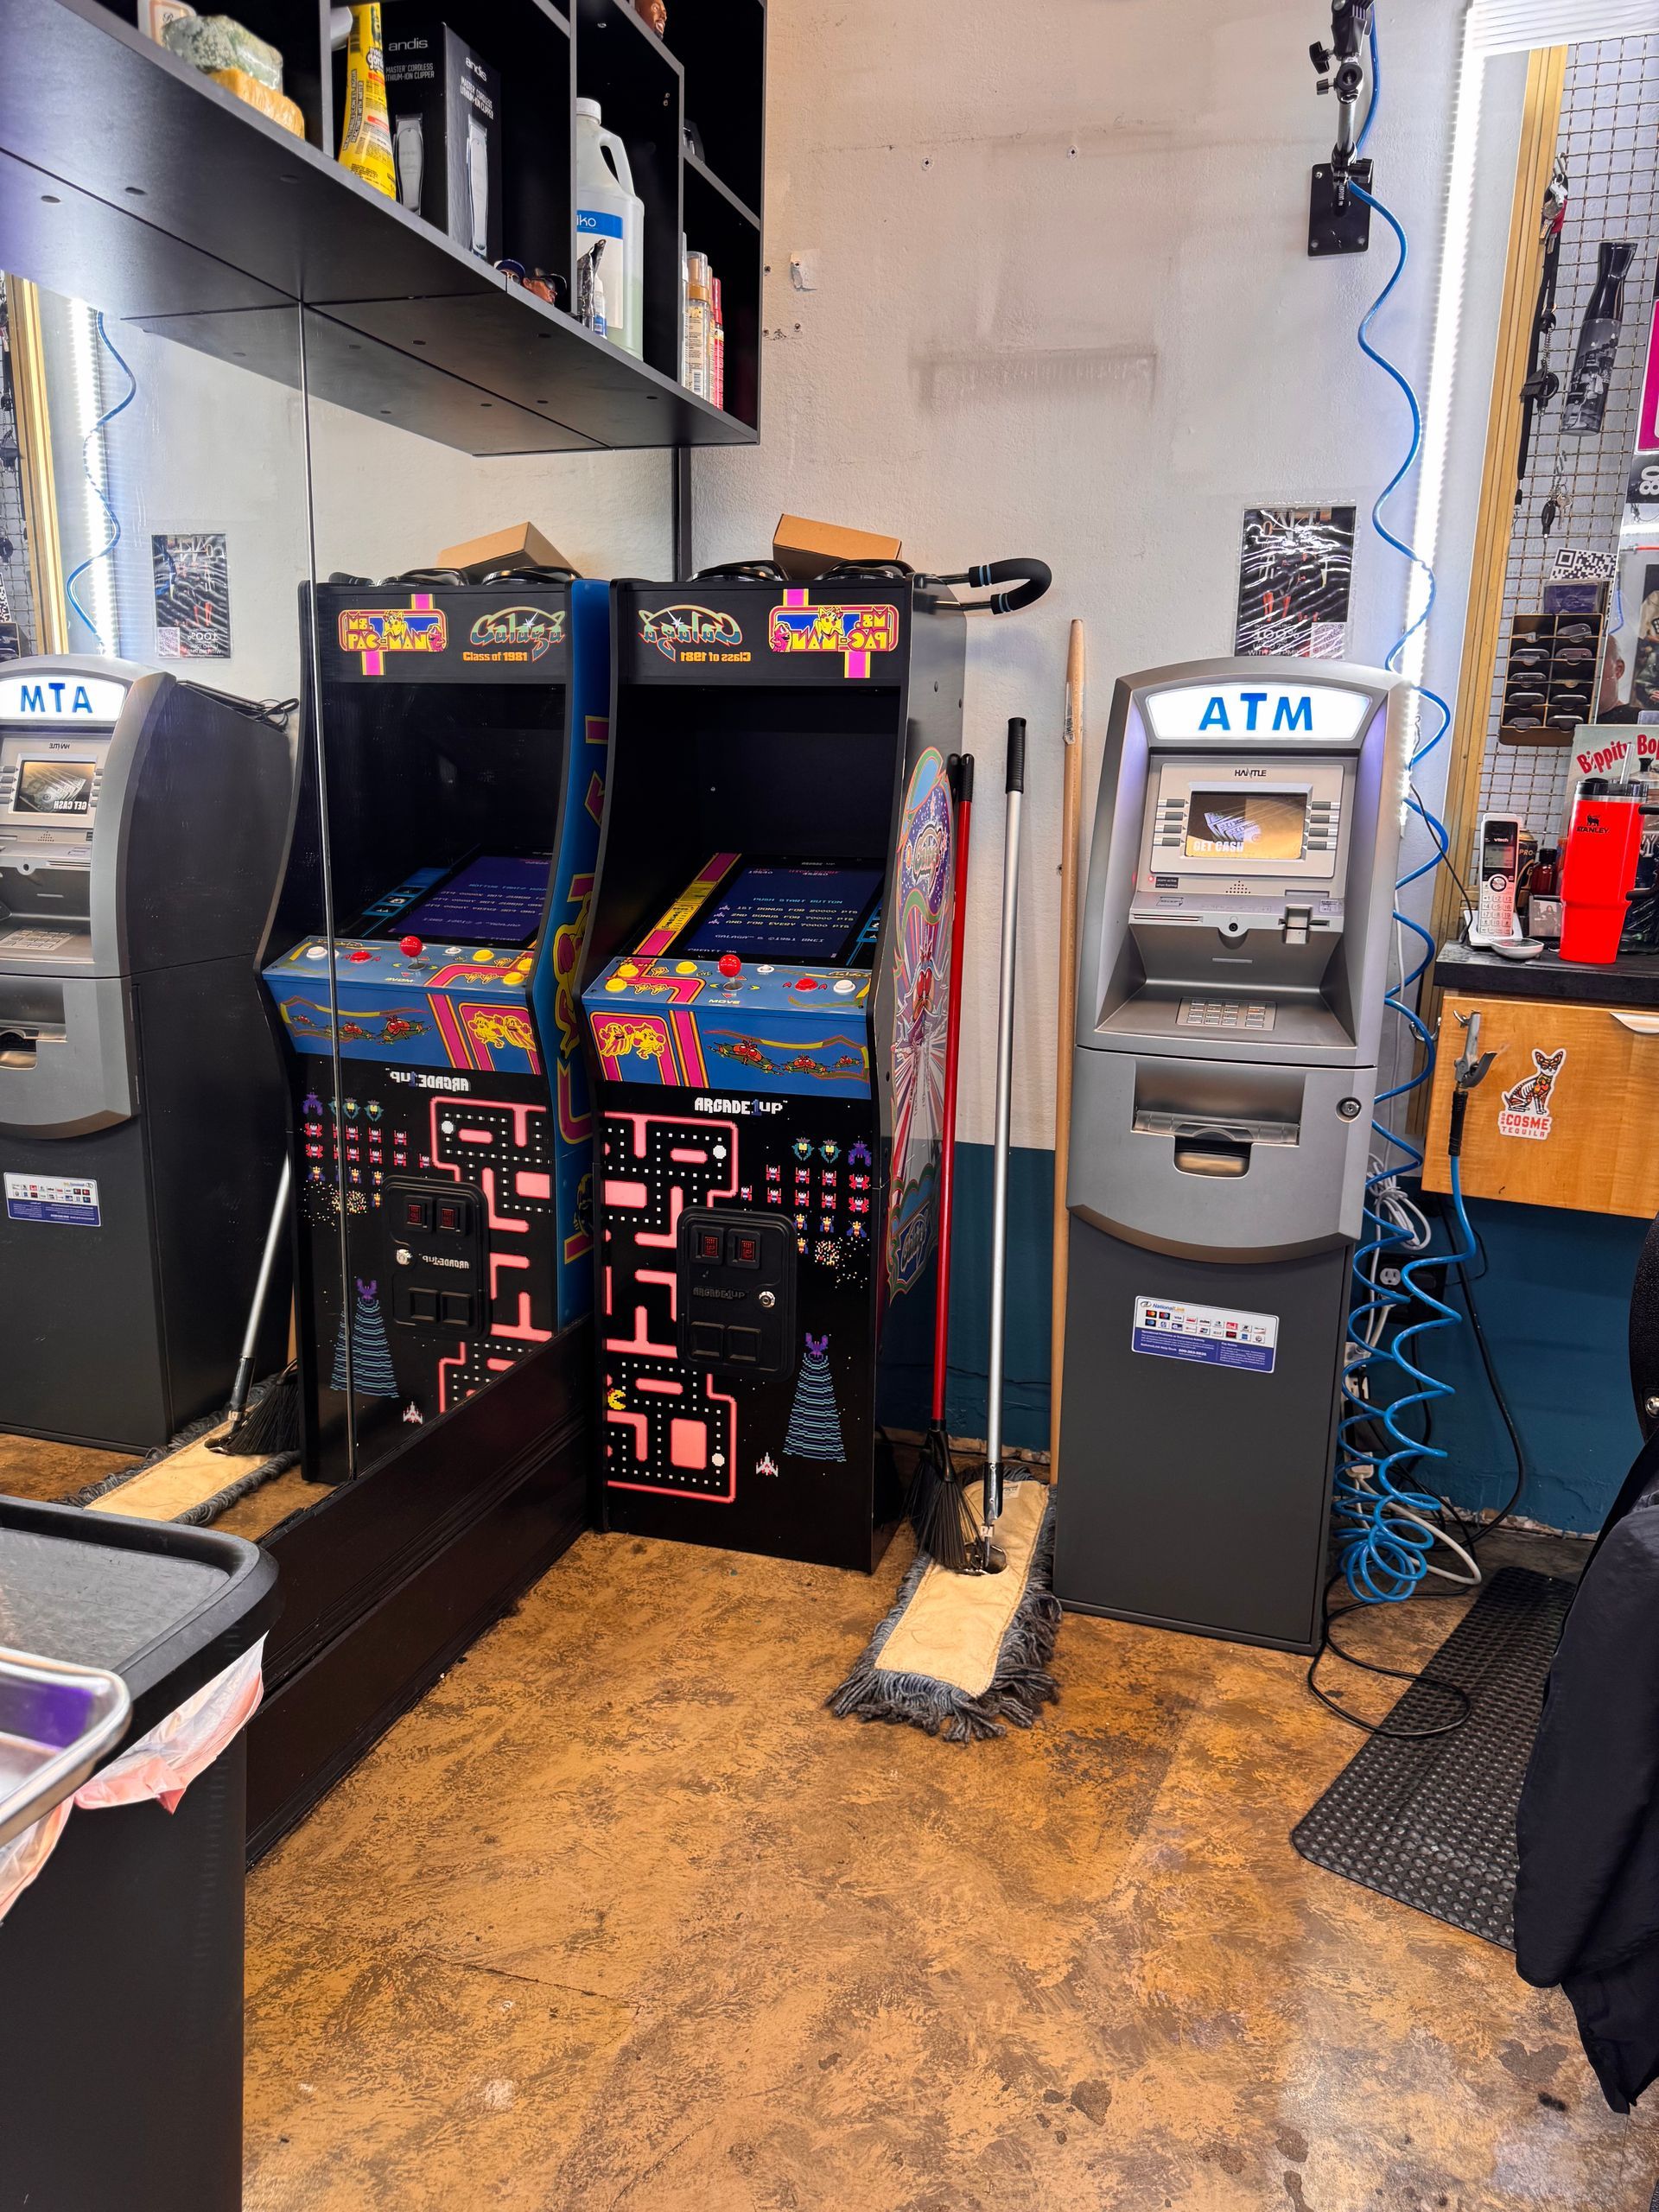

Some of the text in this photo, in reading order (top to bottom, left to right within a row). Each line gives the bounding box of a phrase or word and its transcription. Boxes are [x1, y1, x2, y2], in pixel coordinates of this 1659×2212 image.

[388, 38, 428, 51] andis
[408, 63, 434, 73] CORDLESS
[465, 56, 487, 82] andis
[385, 73, 413, 81] ITHIUM-ION
[346, 628, 429, 652] PAC-MAN
[469, 606, 566, 662] Galaga
[463, 651, 528, 662] Class of 1981
[1198, 692, 1313, 732] ATM
[1234, 768, 1268, 778] HANTLE
[1192, 841, 1244, 853] GET CASH
[1506, 1113, 1549, 1130] COSME
[1502, 1126, 1545, 1138] TEQUILA
